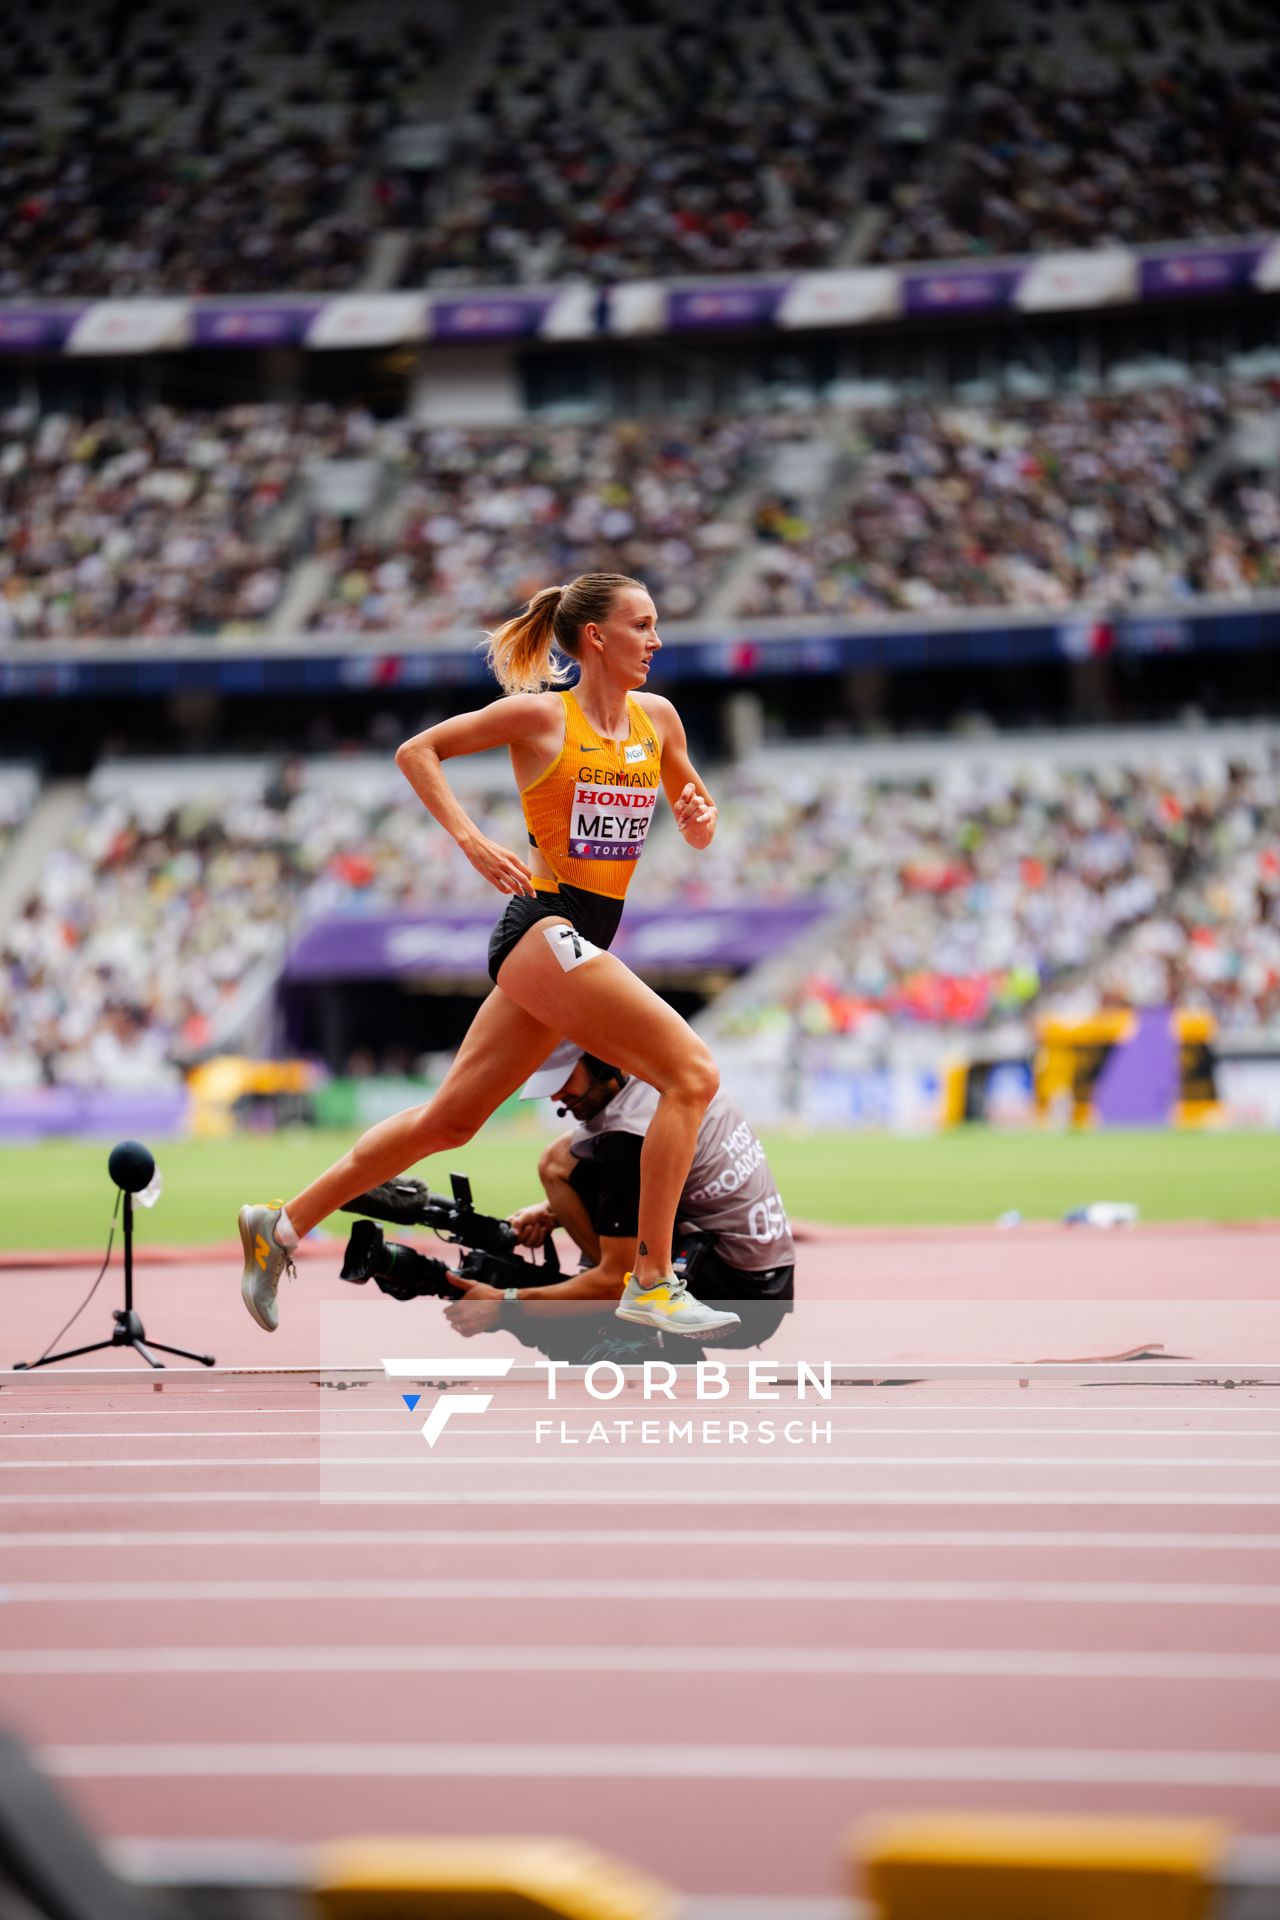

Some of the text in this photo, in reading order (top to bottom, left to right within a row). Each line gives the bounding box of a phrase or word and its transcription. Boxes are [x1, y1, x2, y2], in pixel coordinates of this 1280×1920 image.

[578, 766, 658, 788] GERMANY
[576, 789, 656, 808] HONDA
[577, 813, 649, 839] MEYER
[560, 930, 582, 959] 7
[720, 1120, 753, 1158] HOST
